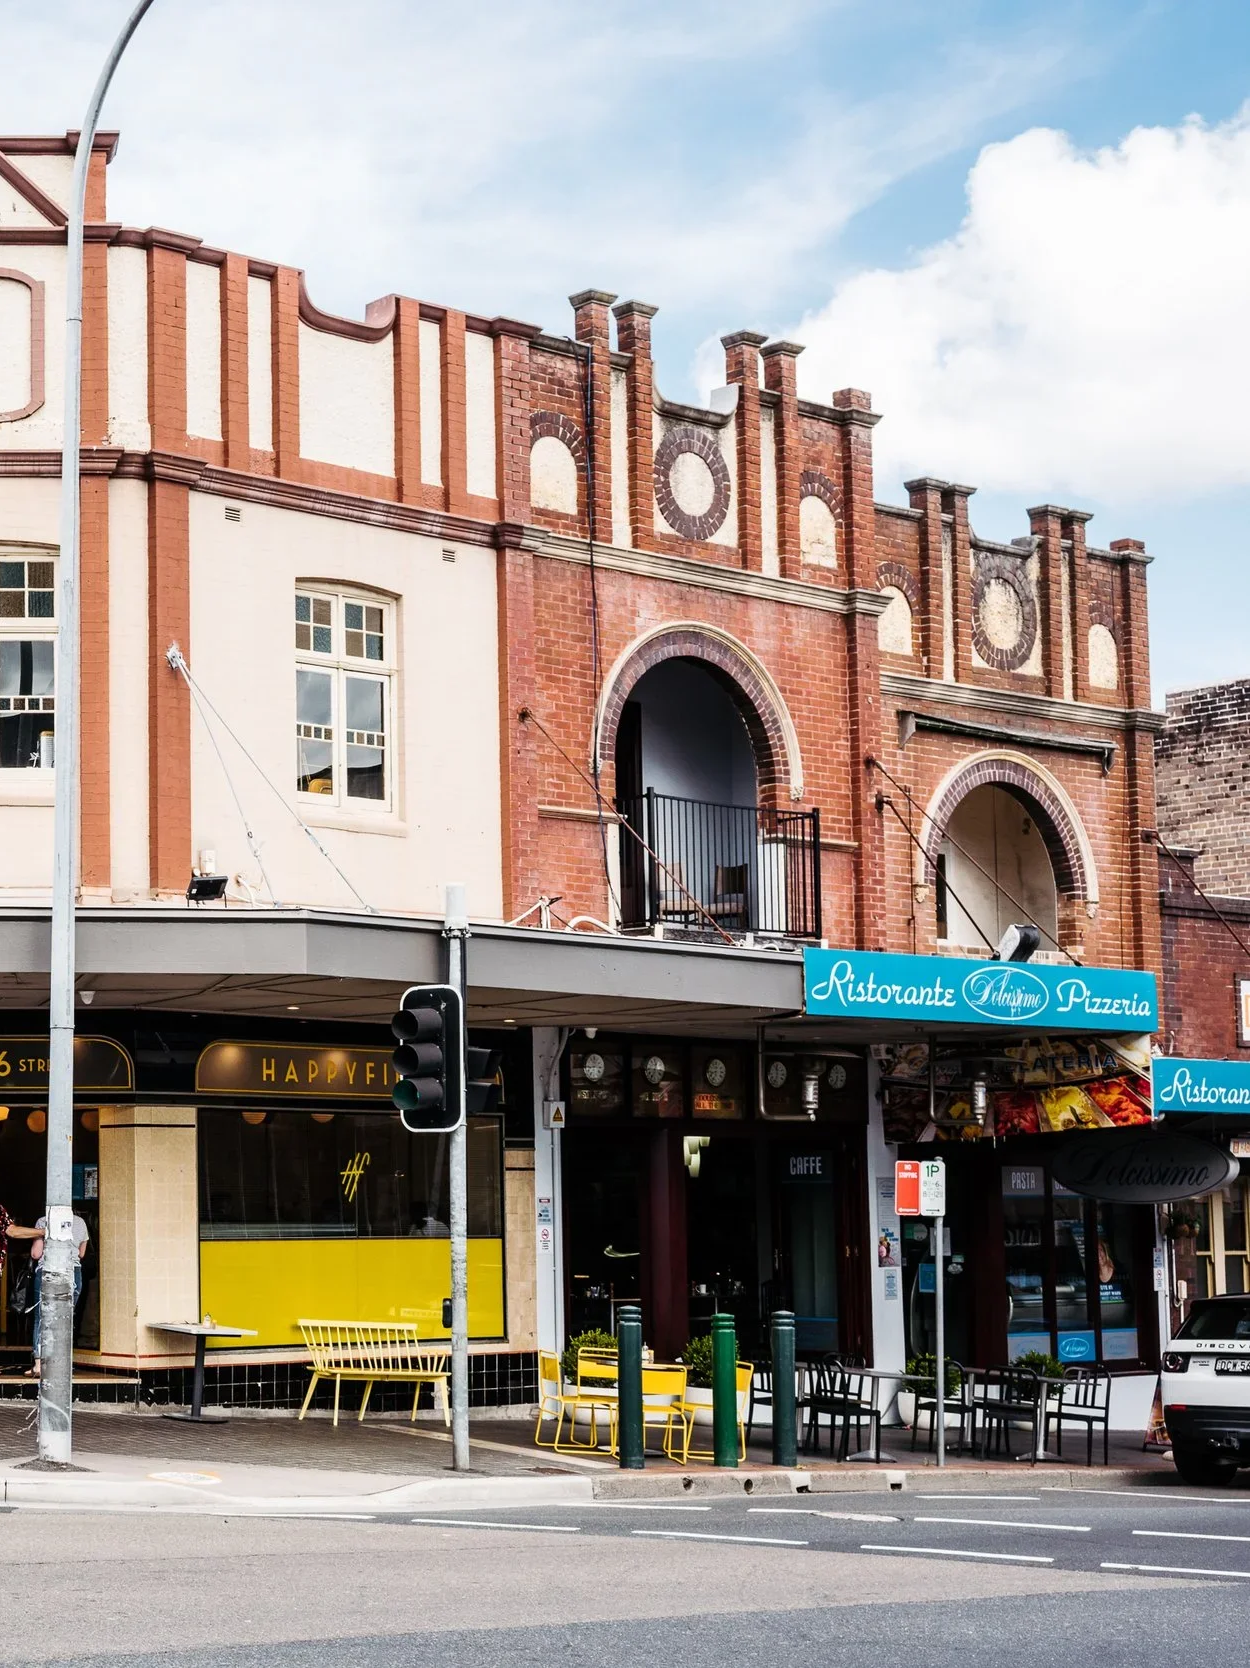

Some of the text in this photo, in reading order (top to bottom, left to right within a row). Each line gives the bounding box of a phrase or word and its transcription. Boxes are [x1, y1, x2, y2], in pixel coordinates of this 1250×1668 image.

[811, 959, 957, 1007] Ristorante
[1056, 978, 1152, 1017] Pizzeria
[262, 1057, 401, 1086] HAPPYFI
[789, 1156, 823, 1175] CAFFE
[1011, 1171, 1036, 1189] PASTA
